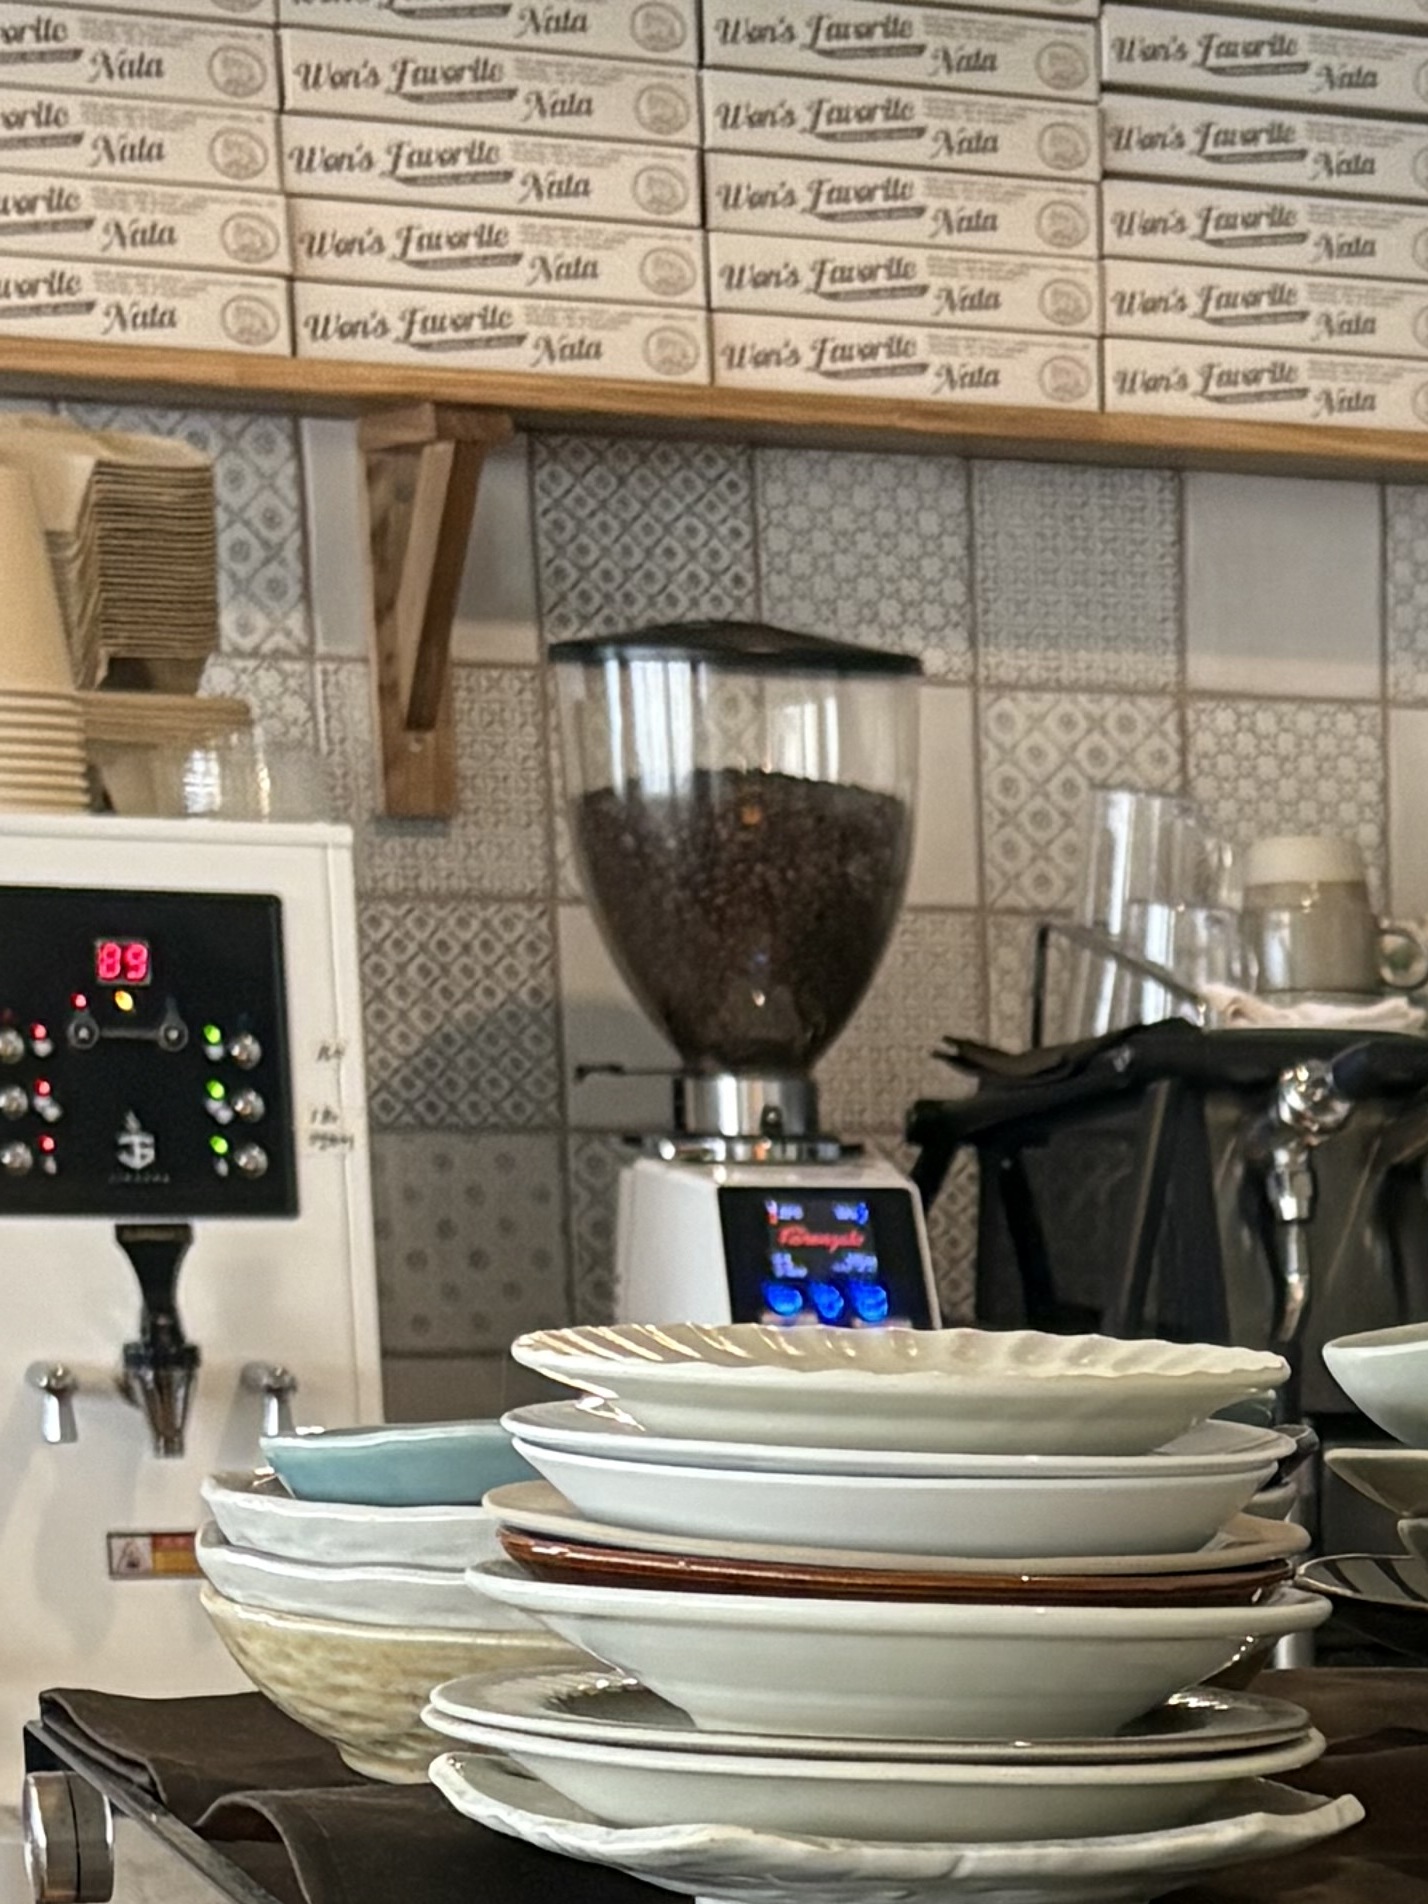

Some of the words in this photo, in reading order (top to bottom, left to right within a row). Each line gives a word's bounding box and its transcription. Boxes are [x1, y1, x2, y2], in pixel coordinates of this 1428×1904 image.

[514, 7, 588, 38] Nata
[714, 15, 796, 46] Won's
[797, 14, 914, 51] Favorite
[86, 50, 163, 82] Nata
[930, 45, 998, 74] Nata
[1110, 36, 1188, 64] Won's
[1190, 33, 1298, 68] Favorite
[292, 59, 381, 92] Won's
[384, 57, 503, 94] Favorite
[1310, 65, 1378, 93] Nata
[520, 90, 594, 121] Nata
[714, 99, 796, 130] Won's
[798, 97, 915, 134] Favorite
[87, 134, 164, 166] Nata
[931, 127, 999, 156] Nata
[1108, 125, 1186, 153] Won's
[1188, 121, 1296, 156] Favorite
[286, 143, 375, 176] Won's
[379, 140, 498, 177] Favorite
[1308, 152, 1376, 180] Nata
[517, 171, 591, 202] Nata
[715, 180, 797, 211] Won's
[798, 177, 915, 214] Favorite
[98, 218, 175, 250] Nata
[930, 206, 998, 235] Nata
[1110, 209, 1188, 237] Won's
[1189, 204, 1297, 239] Favorite
[297, 227, 386, 260] Won's
[389, 223, 508, 260] Favorite
[1309, 234, 1377, 262] Nata
[525, 254, 599, 285] Nata
[718, 260, 800, 291] Won's
[801, 256, 918, 293] Favorite
[933, 284, 1001, 313] Nata
[1110, 288, 1188, 316] Won's
[1190, 283, 1298, 318] Favorite
[99, 301, 176, 333] Nata
[301, 310, 390, 343] Won's
[393, 305, 512, 342] Favorite
[1309, 312, 1377, 340] Nata
[529, 334, 603, 365] Nata
[719, 339, 801, 370] Won's
[802, 334, 919, 371] Favorite
[933, 361, 1001, 390] Nata
[1112, 367, 1190, 395] Won's
[1190, 361, 1298, 396] Favorite
[1309, 389, 1377, 417] Nata
